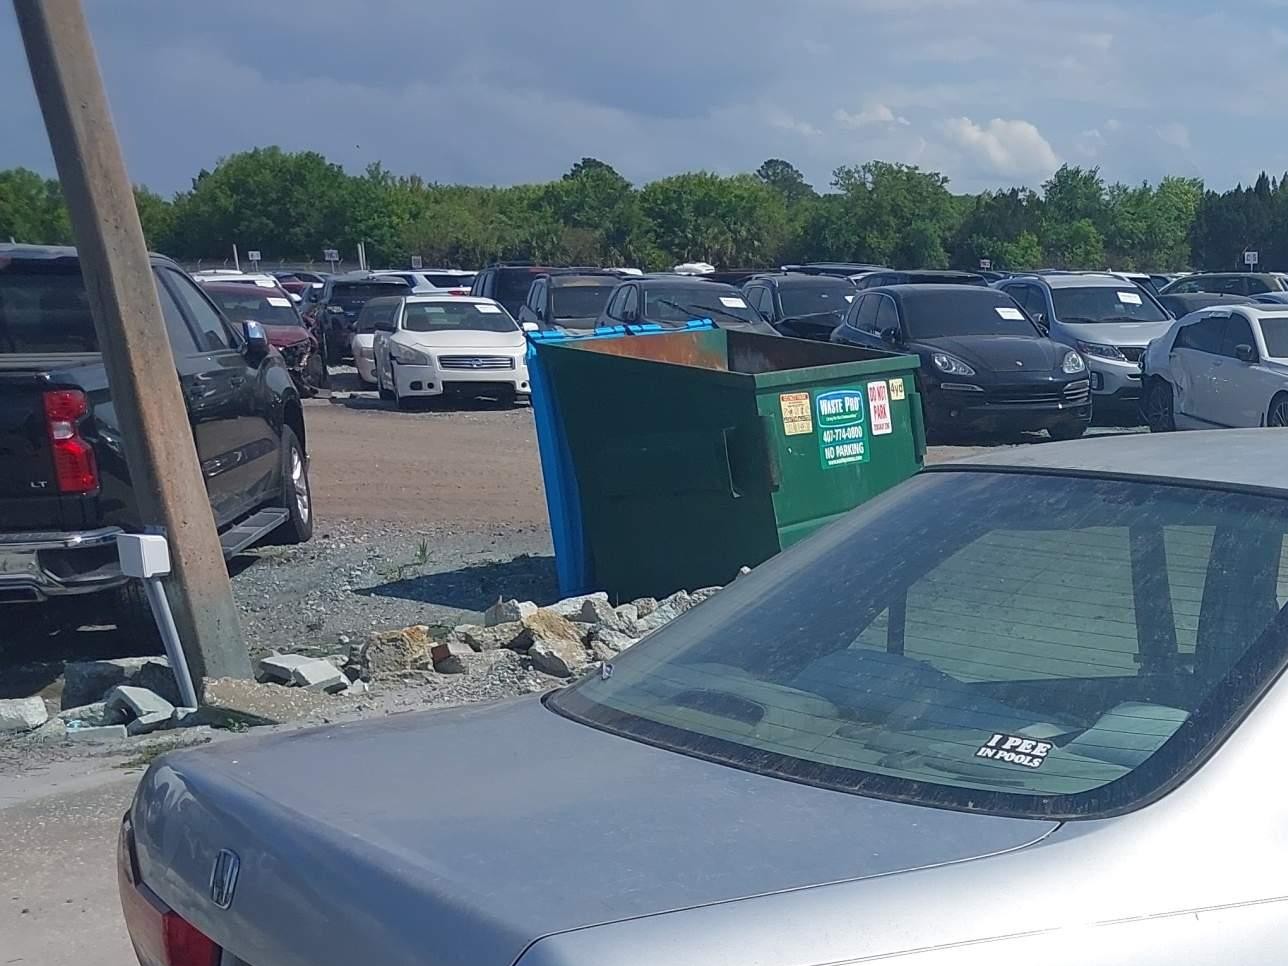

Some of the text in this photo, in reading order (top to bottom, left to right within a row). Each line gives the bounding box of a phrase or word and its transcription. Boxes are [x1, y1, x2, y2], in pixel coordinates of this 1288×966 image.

[869, 385, 887, 401] DO NOT
[890, 382, 903, 396] 4yd
[820, 399, 843, 415] WASTE
[844, 397, 860, 412] PRO
[873, 403, 887, 420] PARK
[825, 442, 864, 460] NO PARKING
[30, 480, 48, 488] LT
[987, 735, 1051, 757] I PEE
[977, 747, 1042, 767] IN POOLS
